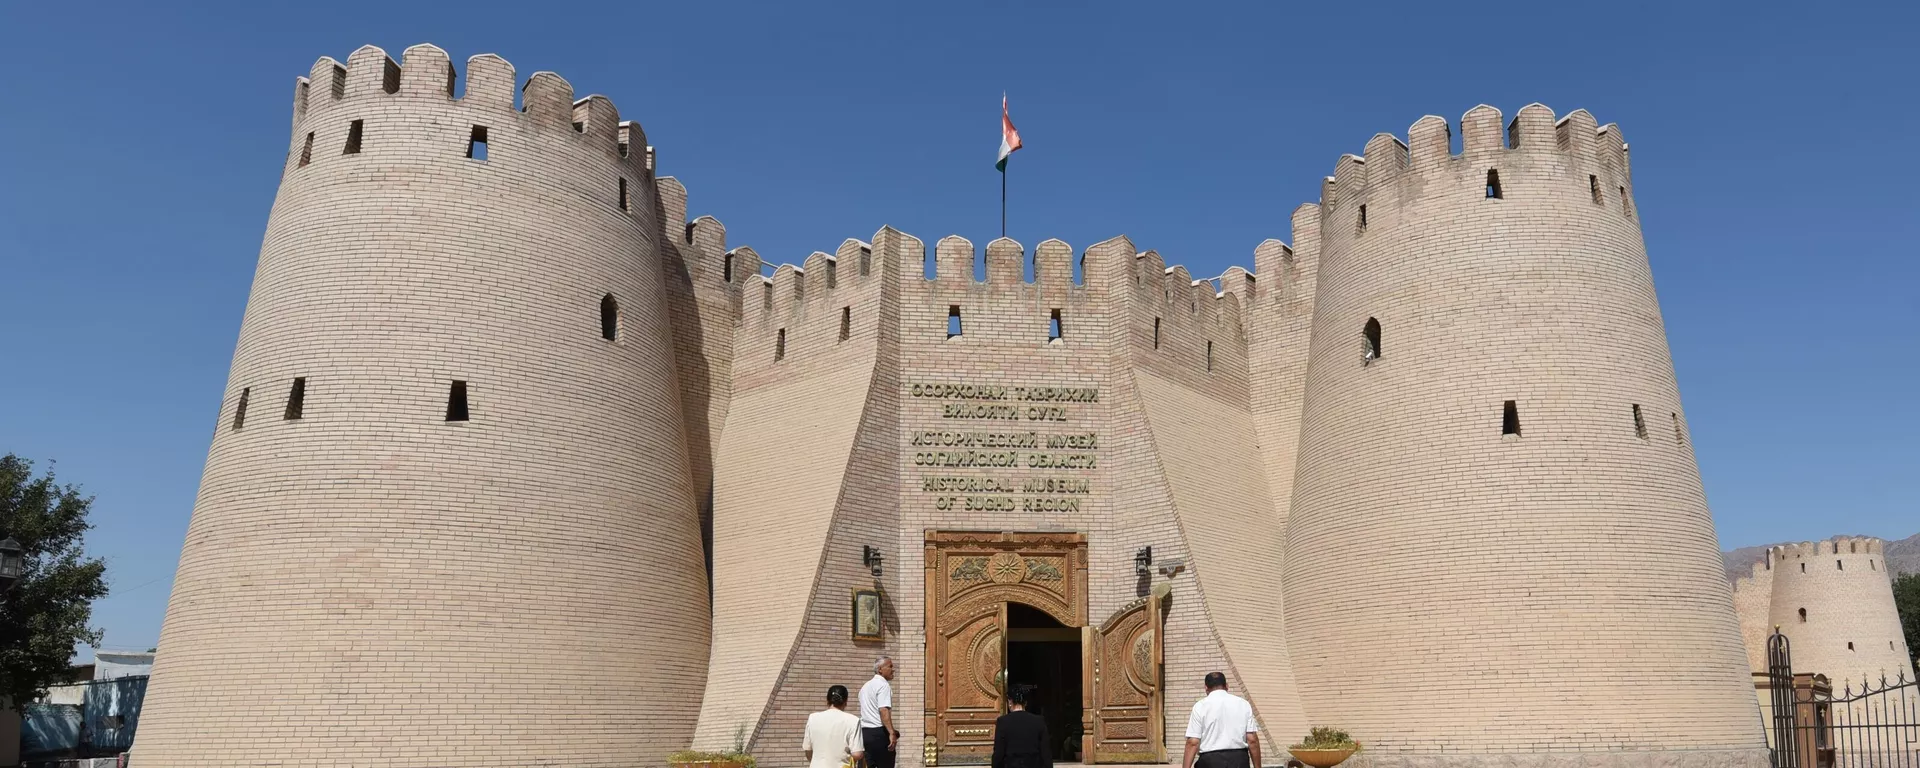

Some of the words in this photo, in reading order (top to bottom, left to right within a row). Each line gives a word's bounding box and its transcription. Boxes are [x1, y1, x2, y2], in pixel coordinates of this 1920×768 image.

[912, 384, 1007, 400] ОСОРХОНАИ
[943, 404, 1018, 420] ВИЛОЯТИ
[912, 431, 1037, 448] ИСТОРИЧЕСКИЙ
[1046, 433, 1097, 449] МУЗЕЙ
[915, 451, 1018, 467] СОГДИЙСКОЙ
[1028, 454, 1096, 469] ОБЛАСТИ
[923, 476, 1014, 492] HISTORICAL
[1023, 478, 1089, 494] MUSEUM
[936, 497, 956, 510] OF
[965, 498, 1015, 512] SUGHD
[1023, 499, 1079, 512] REGION
